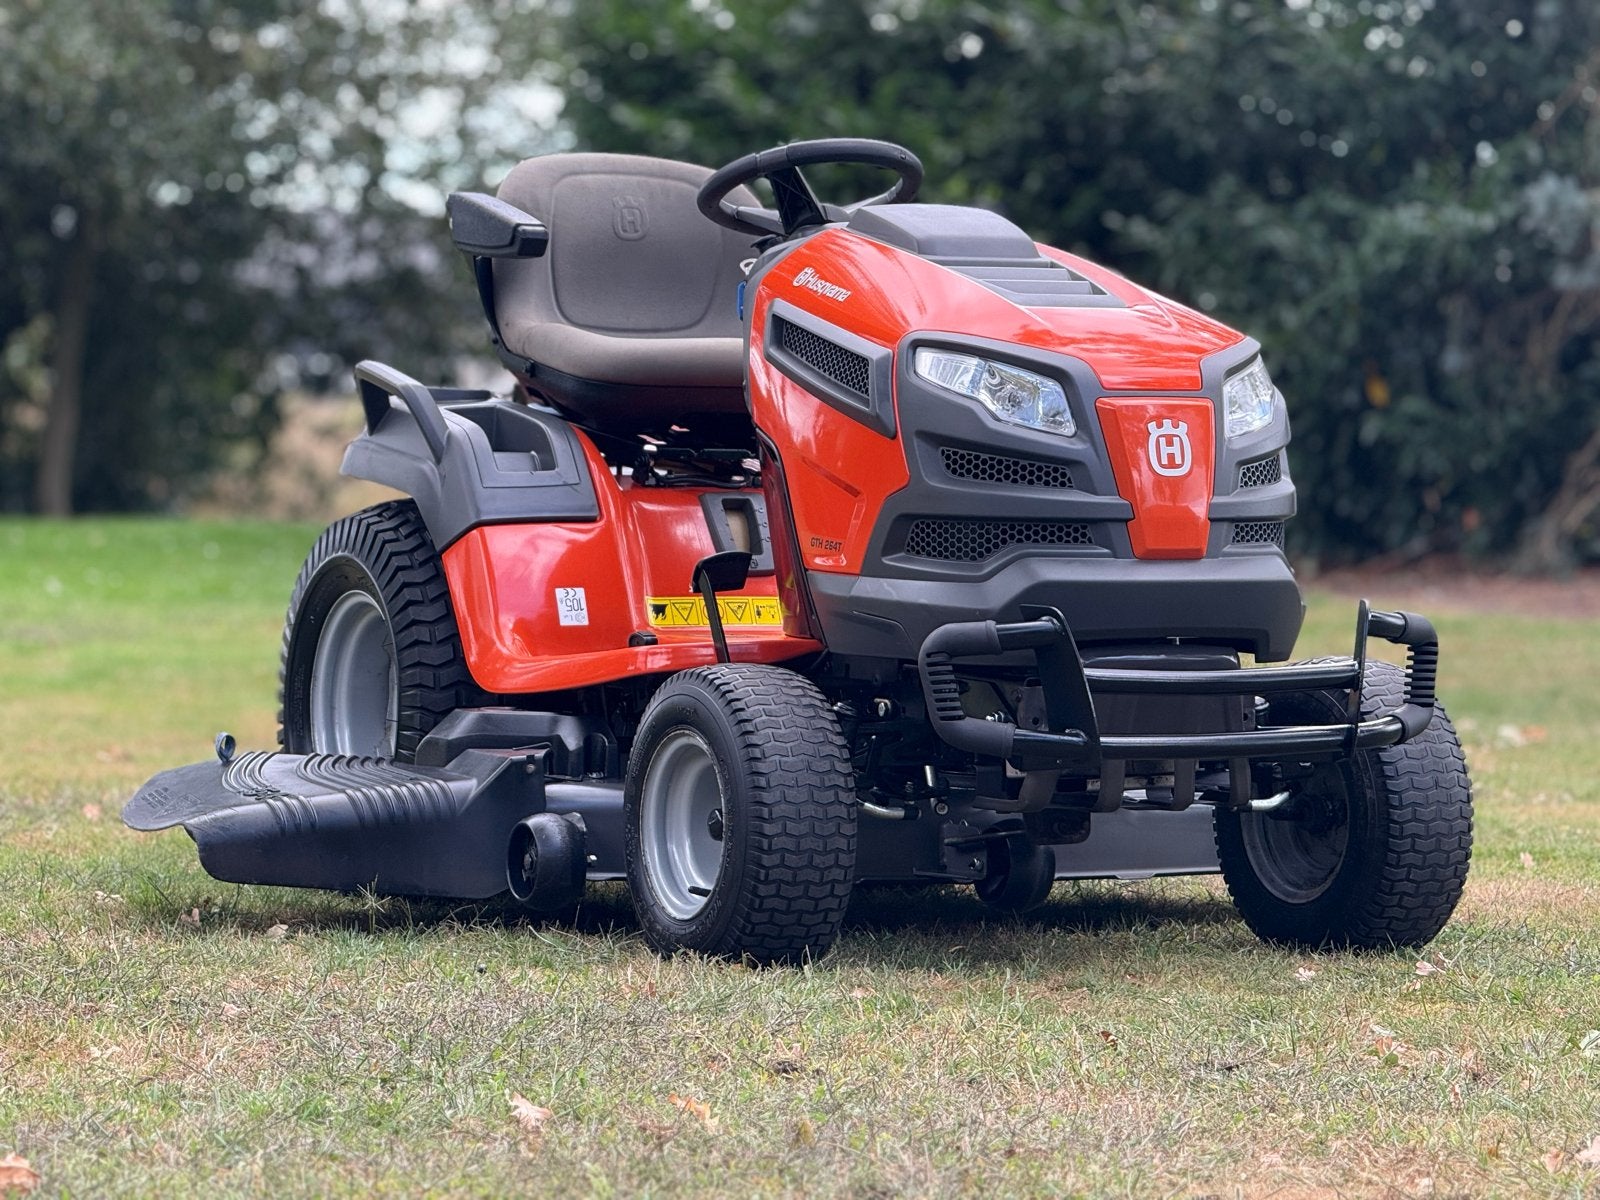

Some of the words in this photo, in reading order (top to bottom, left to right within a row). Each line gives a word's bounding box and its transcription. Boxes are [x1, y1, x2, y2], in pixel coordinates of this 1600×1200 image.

[802, 273, 851, 302] Husqvarna
[810, 537, 824, 549] GTH
[824, 540, 843, 552] 264T
[564, 597, 585, 612] 105
